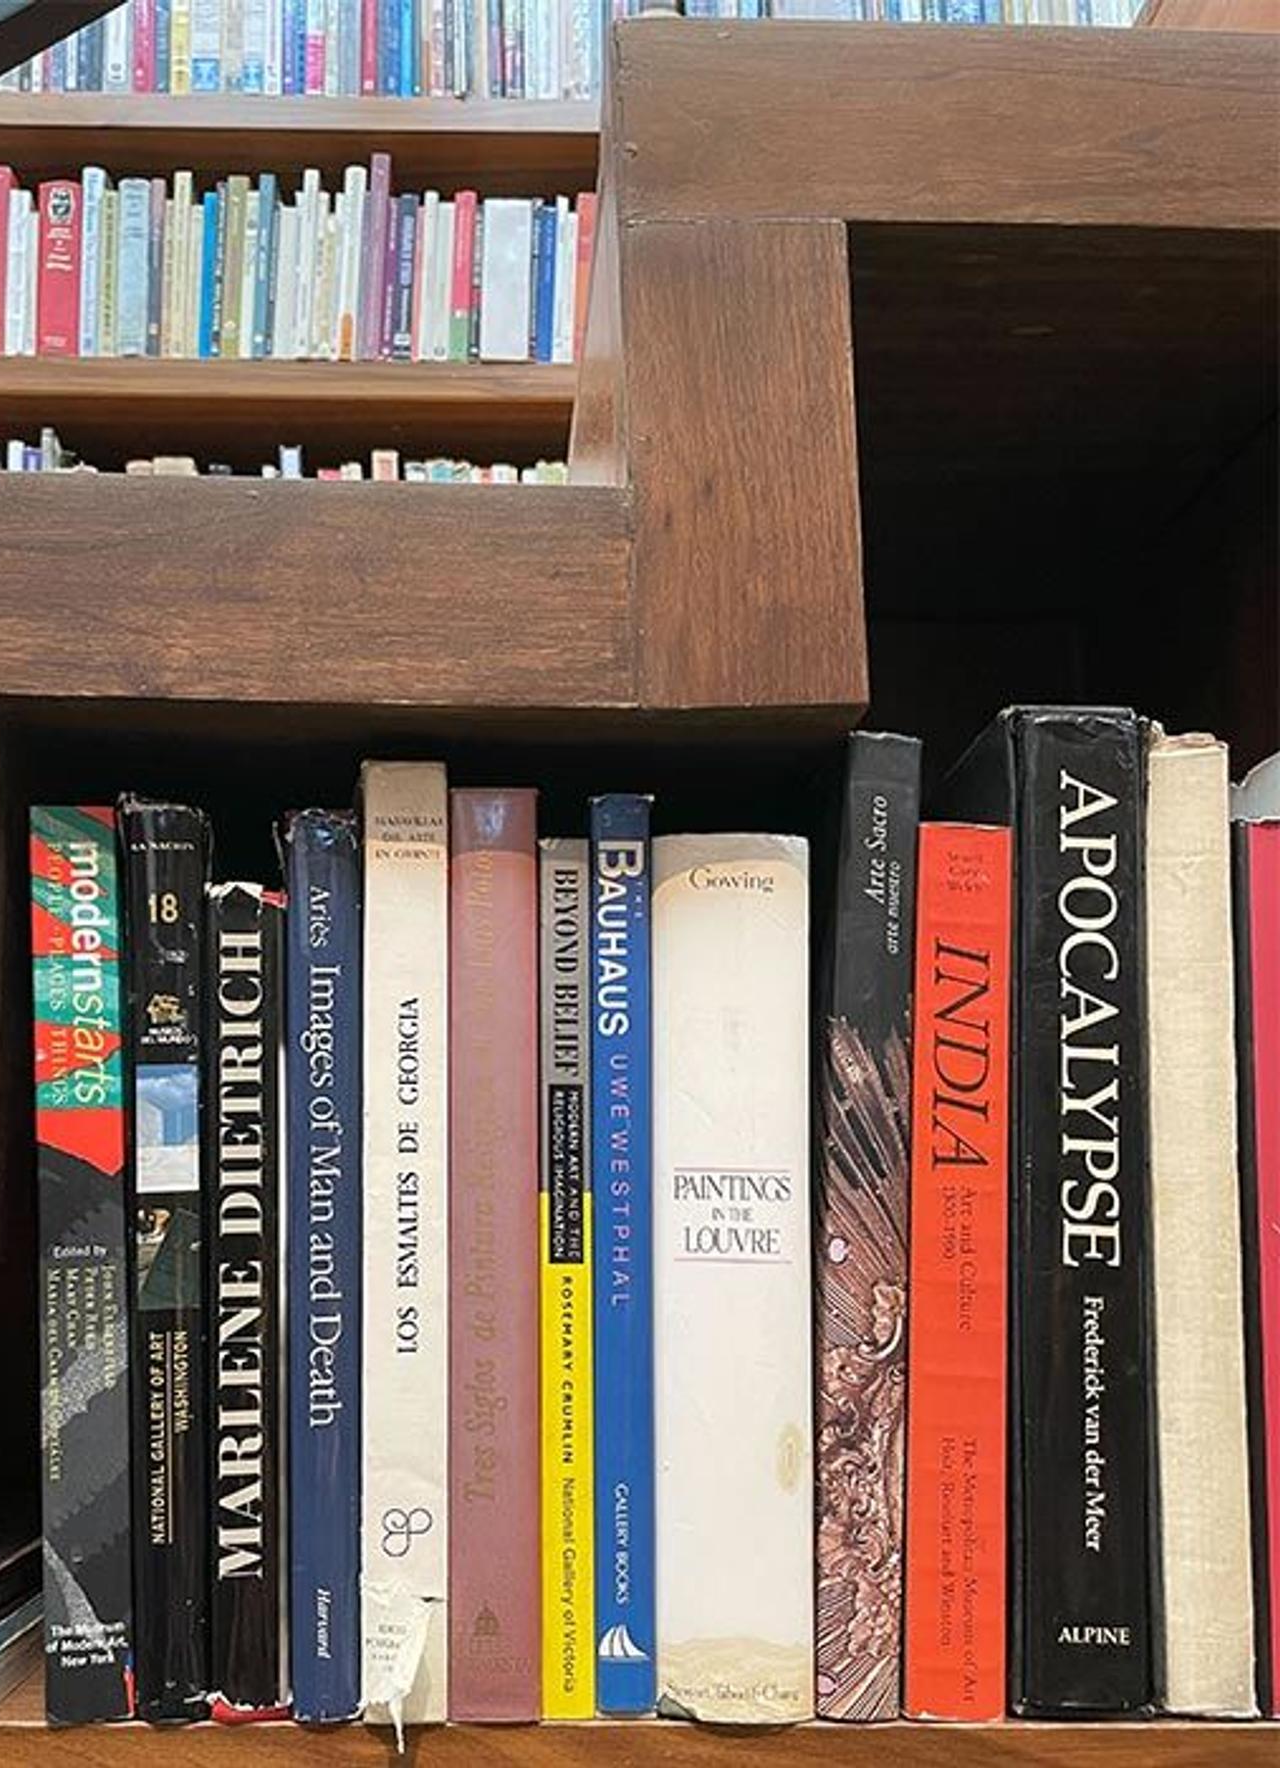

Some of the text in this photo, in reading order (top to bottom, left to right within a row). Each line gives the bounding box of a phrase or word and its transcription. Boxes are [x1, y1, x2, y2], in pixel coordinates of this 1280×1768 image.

[688, 864, 774, 893] Gowing
[863, 795, 888, 905] Arte Sacro
[148, 893, 178, 923] 18
[598, 840, 644, 1037] BAUHAUS
[886, 860, 901, 954] arte nuestro
[46, 840, 69, 1105] PEOPLE PLACES THINGS
[553, 868, 579, 1077] BEYOND BELIEF
[1057, 769, 1120, 1267] APOCALYPSE
[300, 964, 341, 1087] Images
[930, 936, 991, 1172] INDIA
[309, 1096, 343, 1135] of
[309, 1144, 341, 1224] Man
[396, 997, 419, 1354] LOS ESMALTES DE GEORGIA
[552, 1091, 565, 1259] RELIGIOUS IMAGINATION
[567, 1091, 581, 1258] MODERN ART AND THE
[610, 1053, 631, 1306] UWE WESTPHAL
[673, 1174, 791, 1201] PAINTINGS
[52, 1245, 107, 1260] Edited by
[85, 1266, 99, 1308] PETER
[216, 928, 263, 1581] MARLENE DIETRICH
[308, 1232, 343, 1302] and
[685, 1226, 781, 1254] LOUVRE
[959, 1185, 978, 1331] Art and Culture
[65, 1267, 79, 1308] MARY
[469, 1311, 496, 1341] de
[49, 1348, 63, 1406] CARMEN
[174, 1331, 188, 1433] WASHINGTON
[308, 1313, 343, 1428] Death
[464, 1358, 508, 1436] Siglos
[562, 1275, 574, 1464] ROSEMARY CRUMLIN
[150, 1331, 165, 1544] NATIONAL GALLERY OF ART
[1083, 1295, 1105, 1552] Frederick van der Meer
[464, 1445, 495, 1502] Tres
[559, 1477, 578, 1694] National Gallery of Victoria
[615, 1483, 629, 1605] GALLERY BOOKS
[940, 1549, 956, 1577] and
[958, 1437, 979, 1703] The Metropolitan Museum of Art
[45, 1640, 58, 1653] of
[51, 1624, 72, 1637] The
[60, 1650, 114, 1667] New York
[316, 1588, 332, 1659] Harvard
[939, 1581, 955, 1647] Winston
[1057, 1625, 1131, 1646] ALPINE
